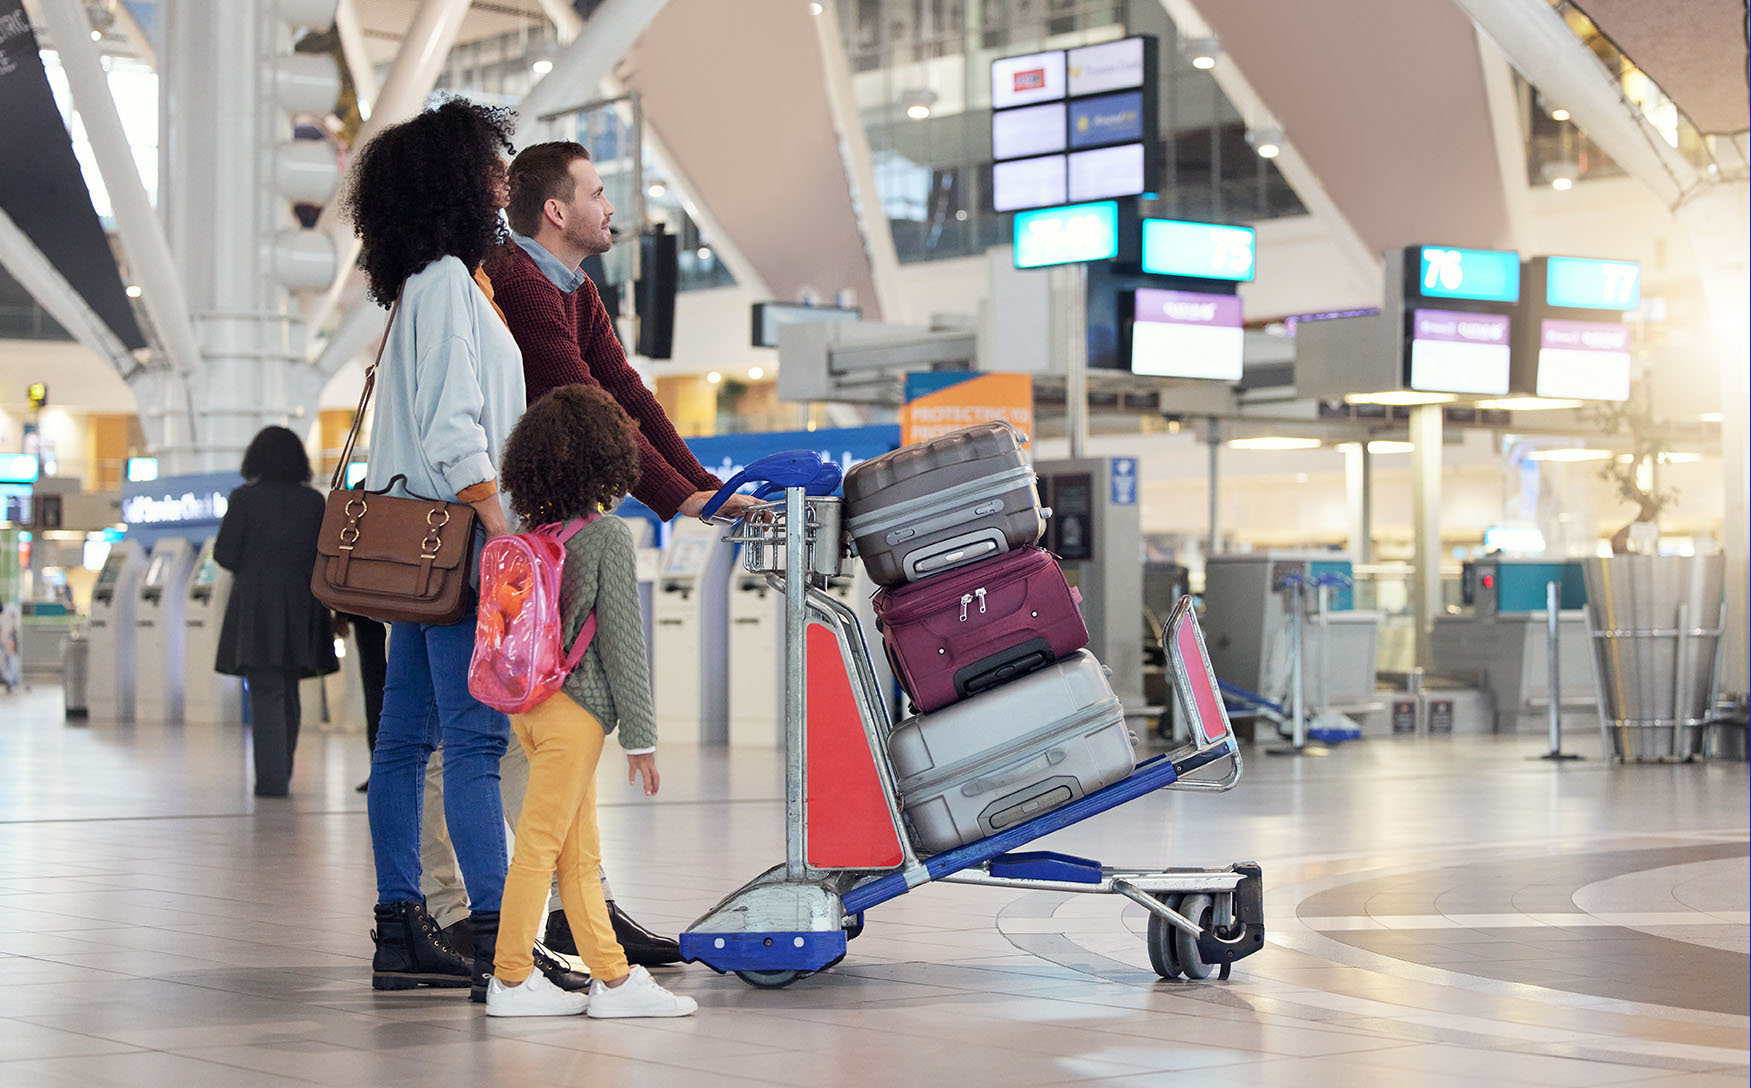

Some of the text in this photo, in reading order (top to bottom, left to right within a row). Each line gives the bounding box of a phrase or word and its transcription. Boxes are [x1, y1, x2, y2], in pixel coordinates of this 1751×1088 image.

[1210, 228, 1254, 273] 75
[1422, 248, 1463, 290] 76
[1601, 263, 1639, 303] 77
